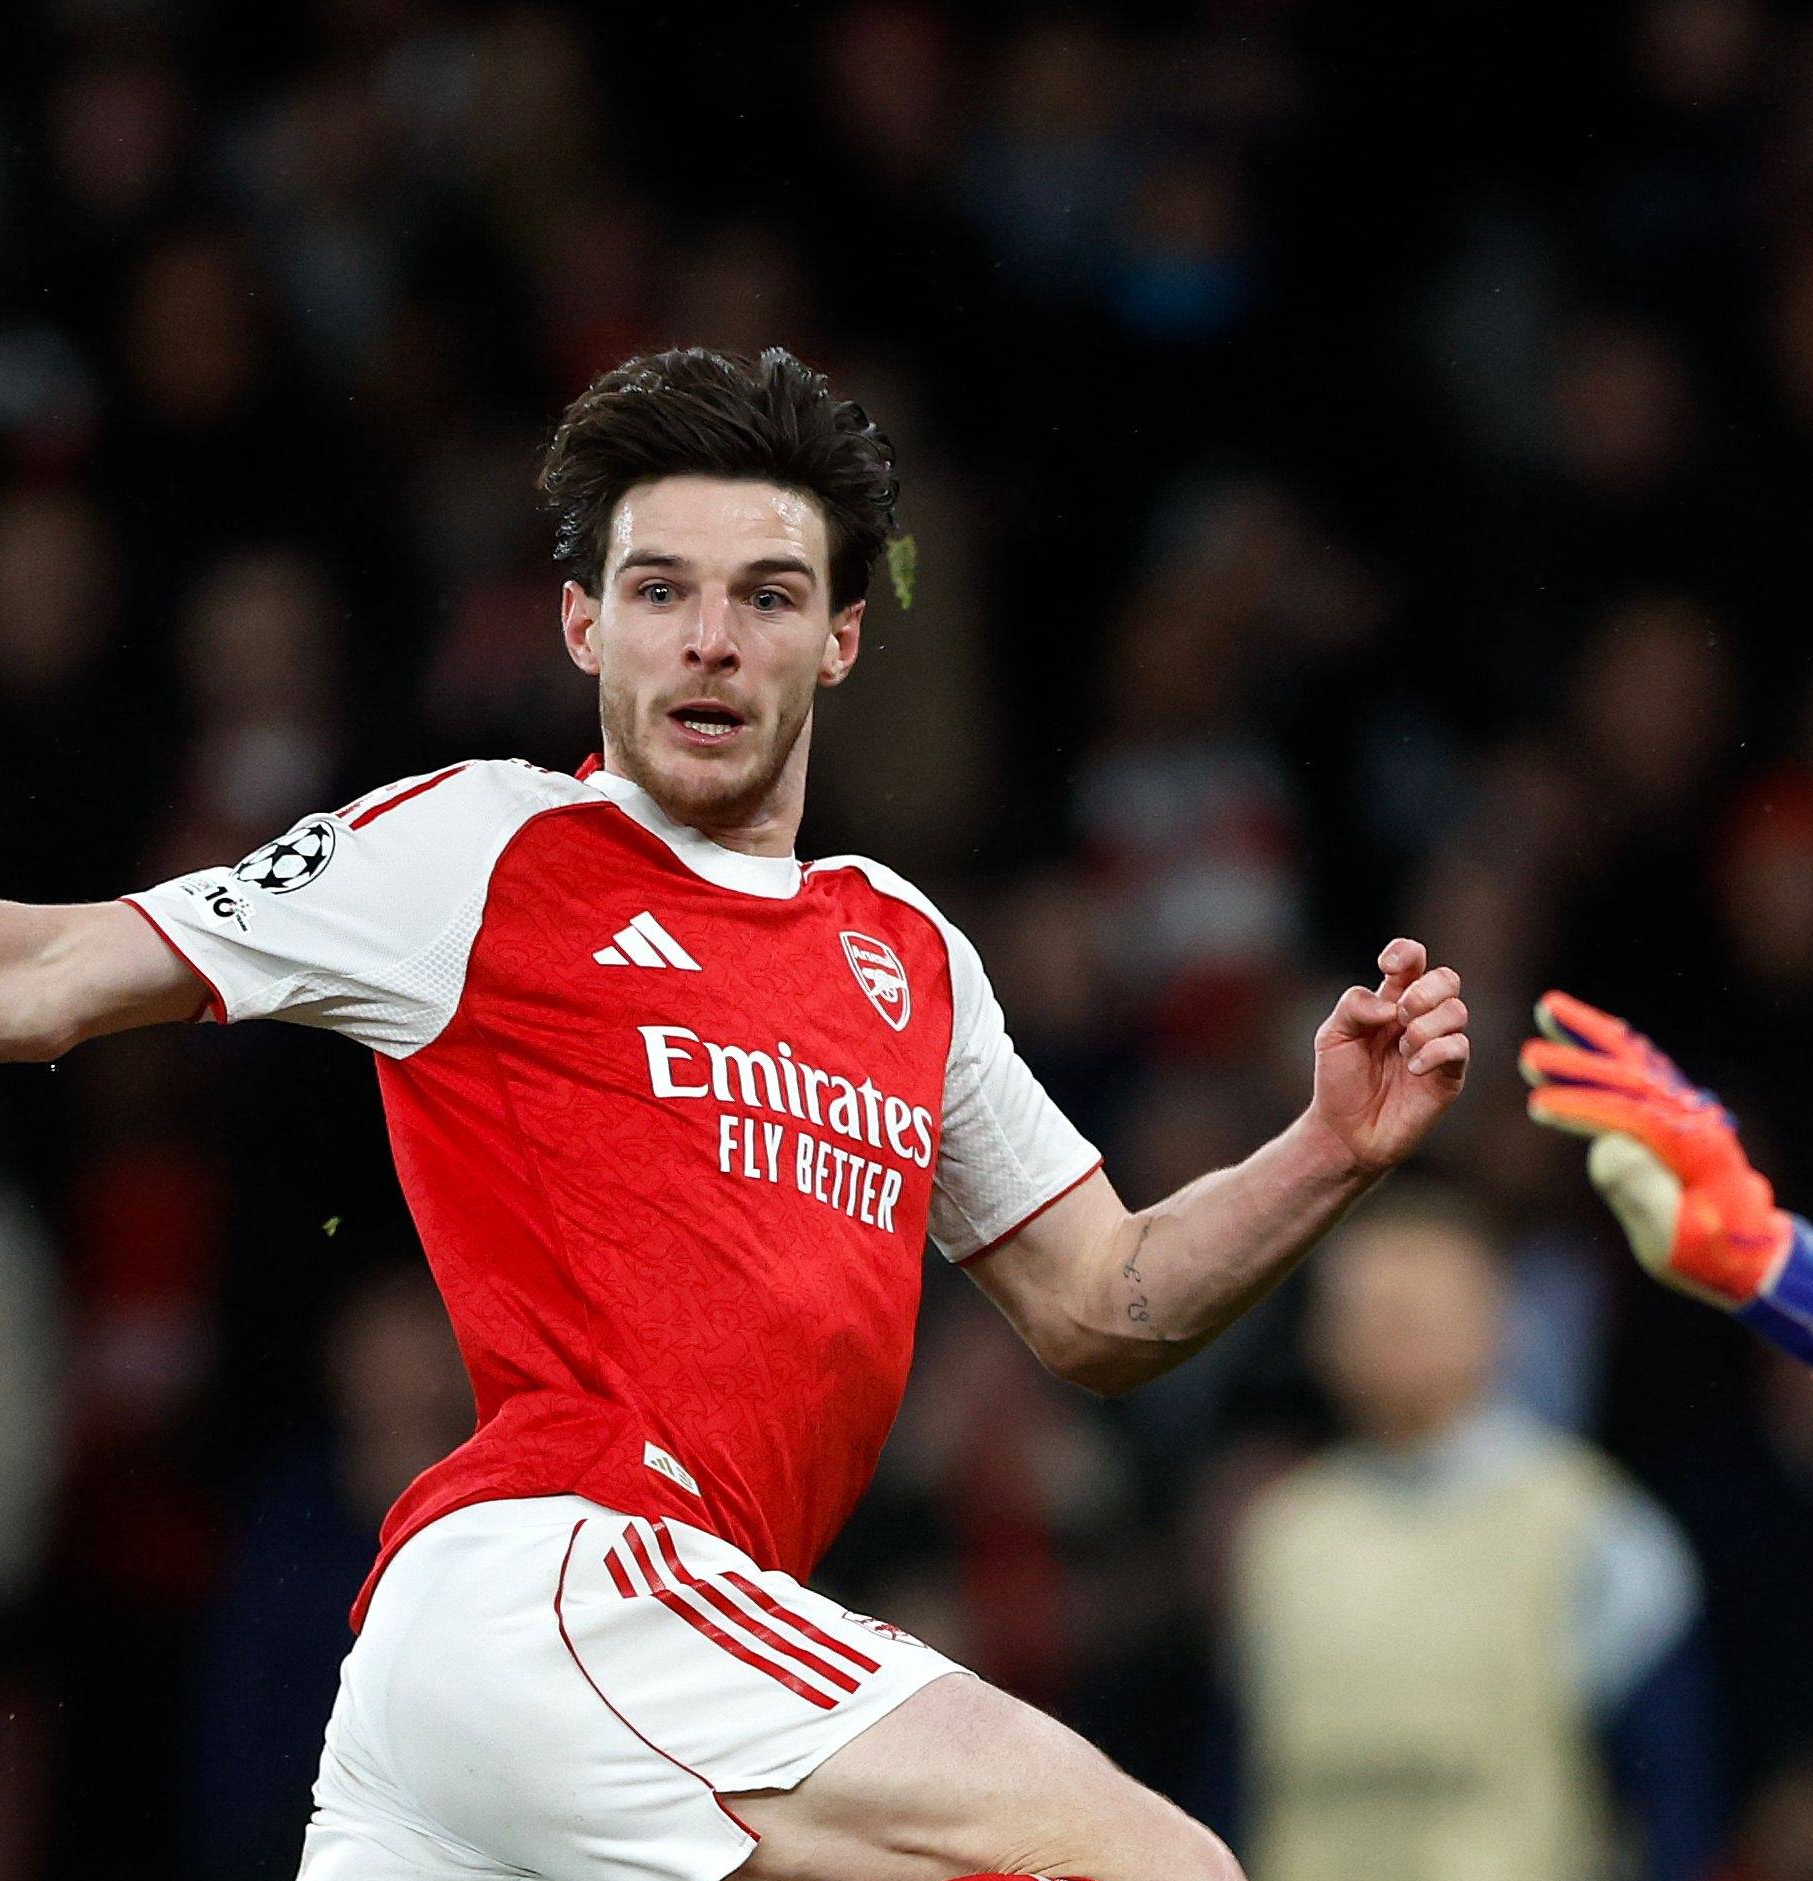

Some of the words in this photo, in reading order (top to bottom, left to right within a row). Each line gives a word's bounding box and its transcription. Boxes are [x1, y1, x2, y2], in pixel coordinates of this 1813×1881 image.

[637, 1025, 932, 1168] Emirates
[719, 1114, 784, 1183] FLY
[797, 1132, 902, 1233] BETTER
